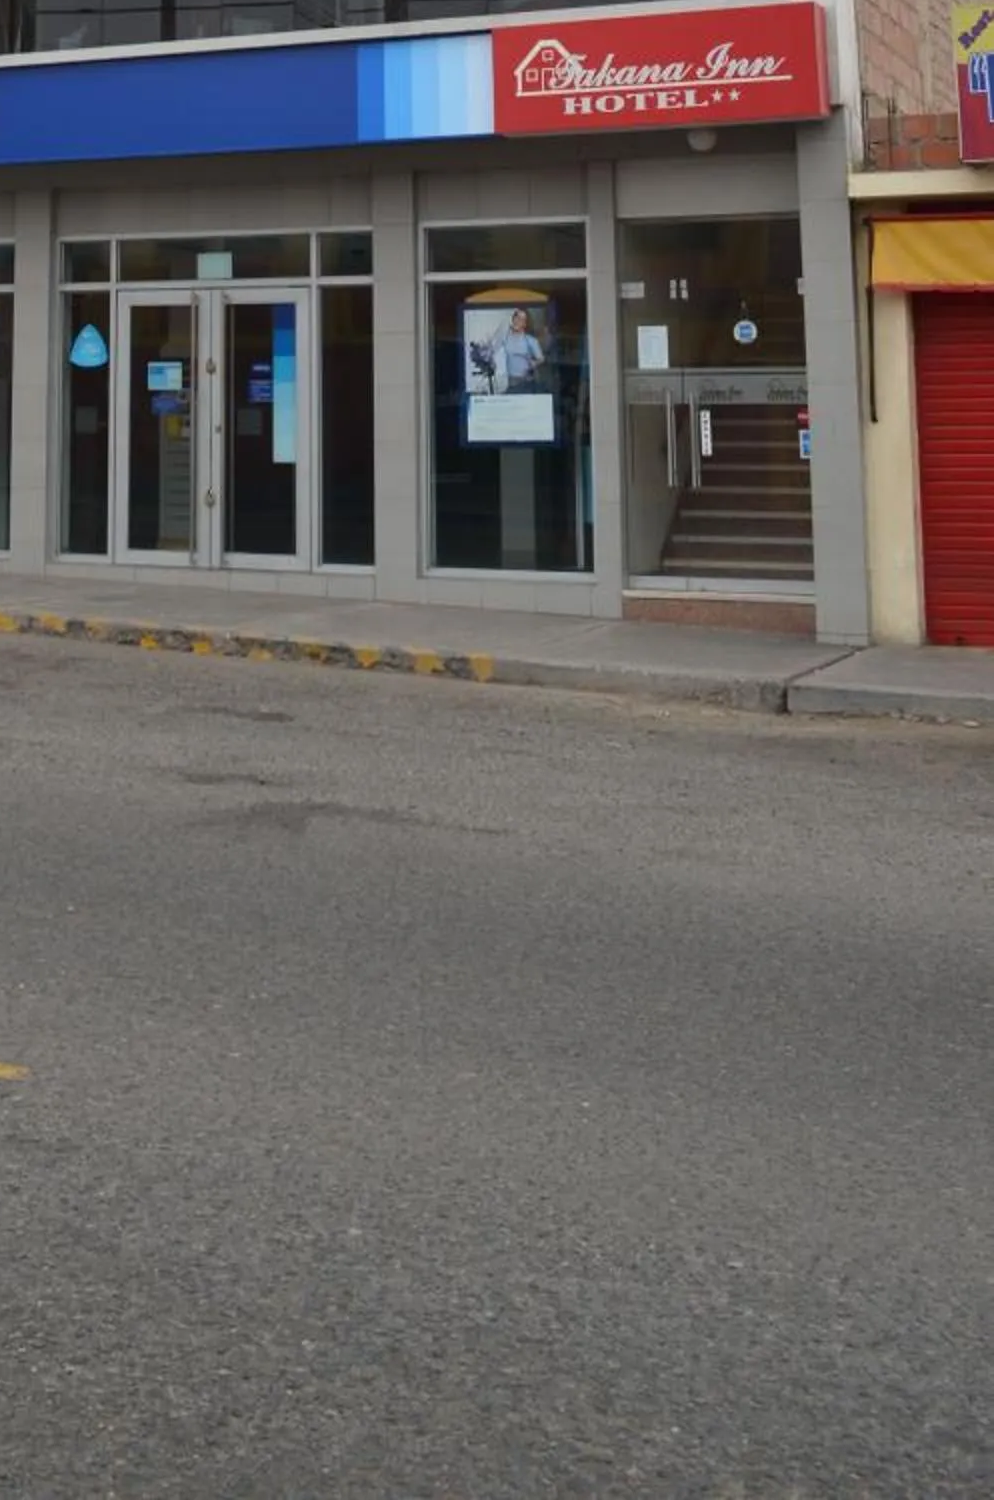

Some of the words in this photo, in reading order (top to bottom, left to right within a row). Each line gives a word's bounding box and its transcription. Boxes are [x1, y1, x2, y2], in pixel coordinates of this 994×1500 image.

[549, 53, 694, 90] Takana
[696, 41, 786, 80] Inn
[563, 89, 709, 116] HOTEL
